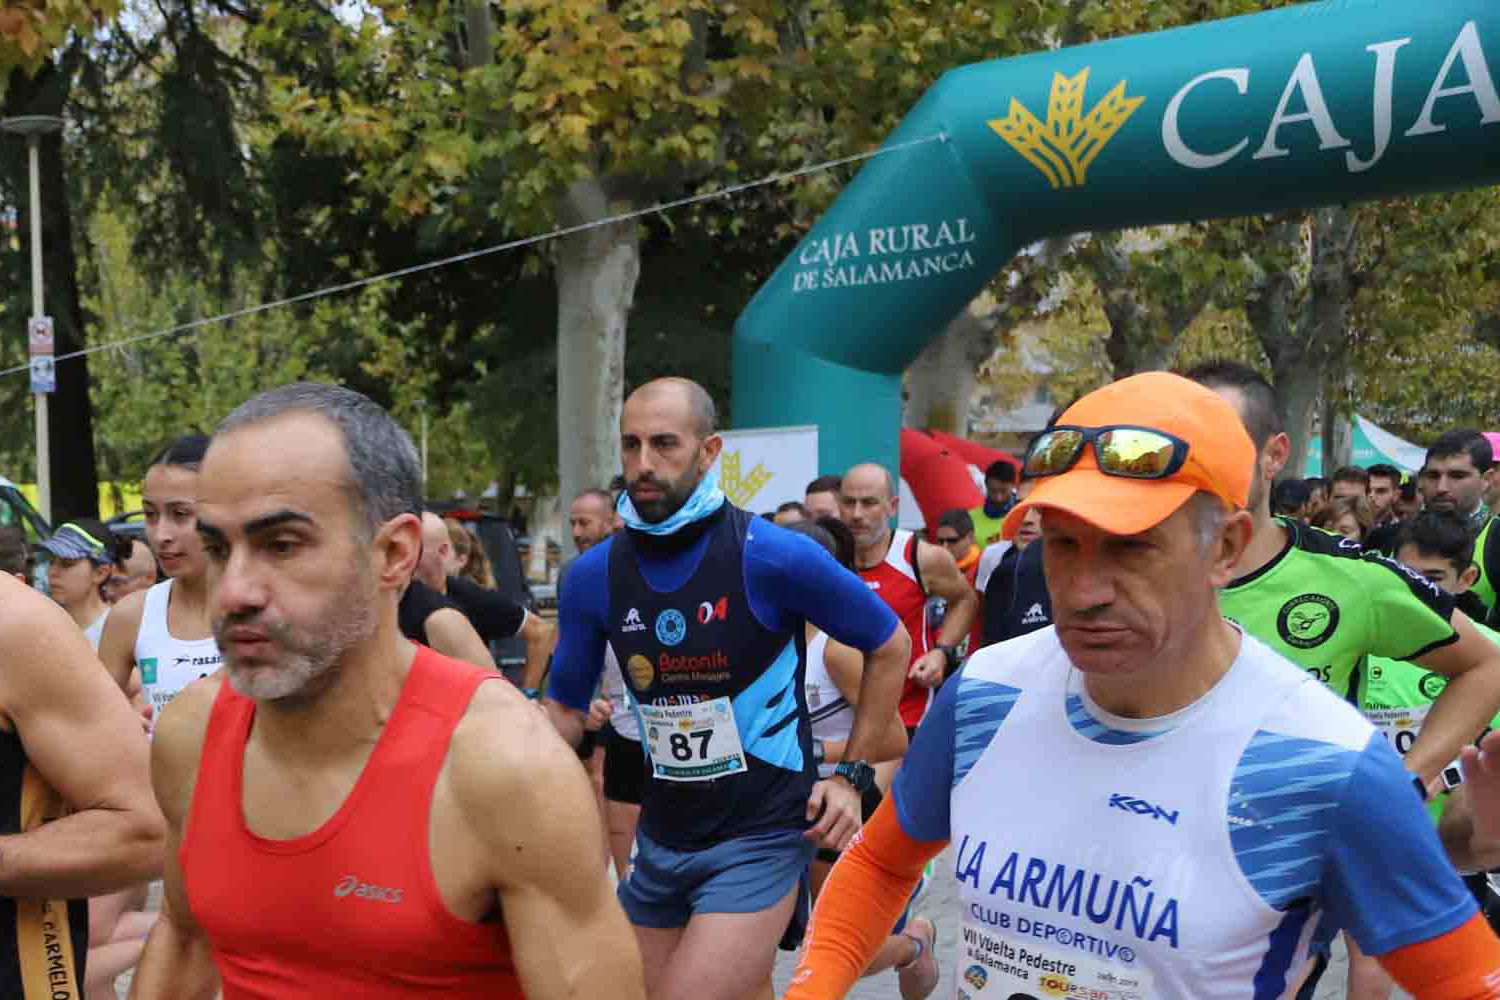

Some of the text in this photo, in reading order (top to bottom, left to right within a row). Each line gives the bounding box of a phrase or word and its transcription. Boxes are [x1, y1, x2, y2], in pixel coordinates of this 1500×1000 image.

[1161, 20, 1500, 172] CAJA
[799, 217, 976, 267] CAJA RURAL
[792, 250, 975, 292] DE SALAMANCA
[670, 729, 713, 761] 87
[956, 834, 1179, 949] LA ARMUÑA
[964, 927, 1077, 977] VII Vuelta Pedestre
[971, 903, 1137, 963] CLUB DEPORTIVO
[975, 948, 1030, 980] Salamanca
